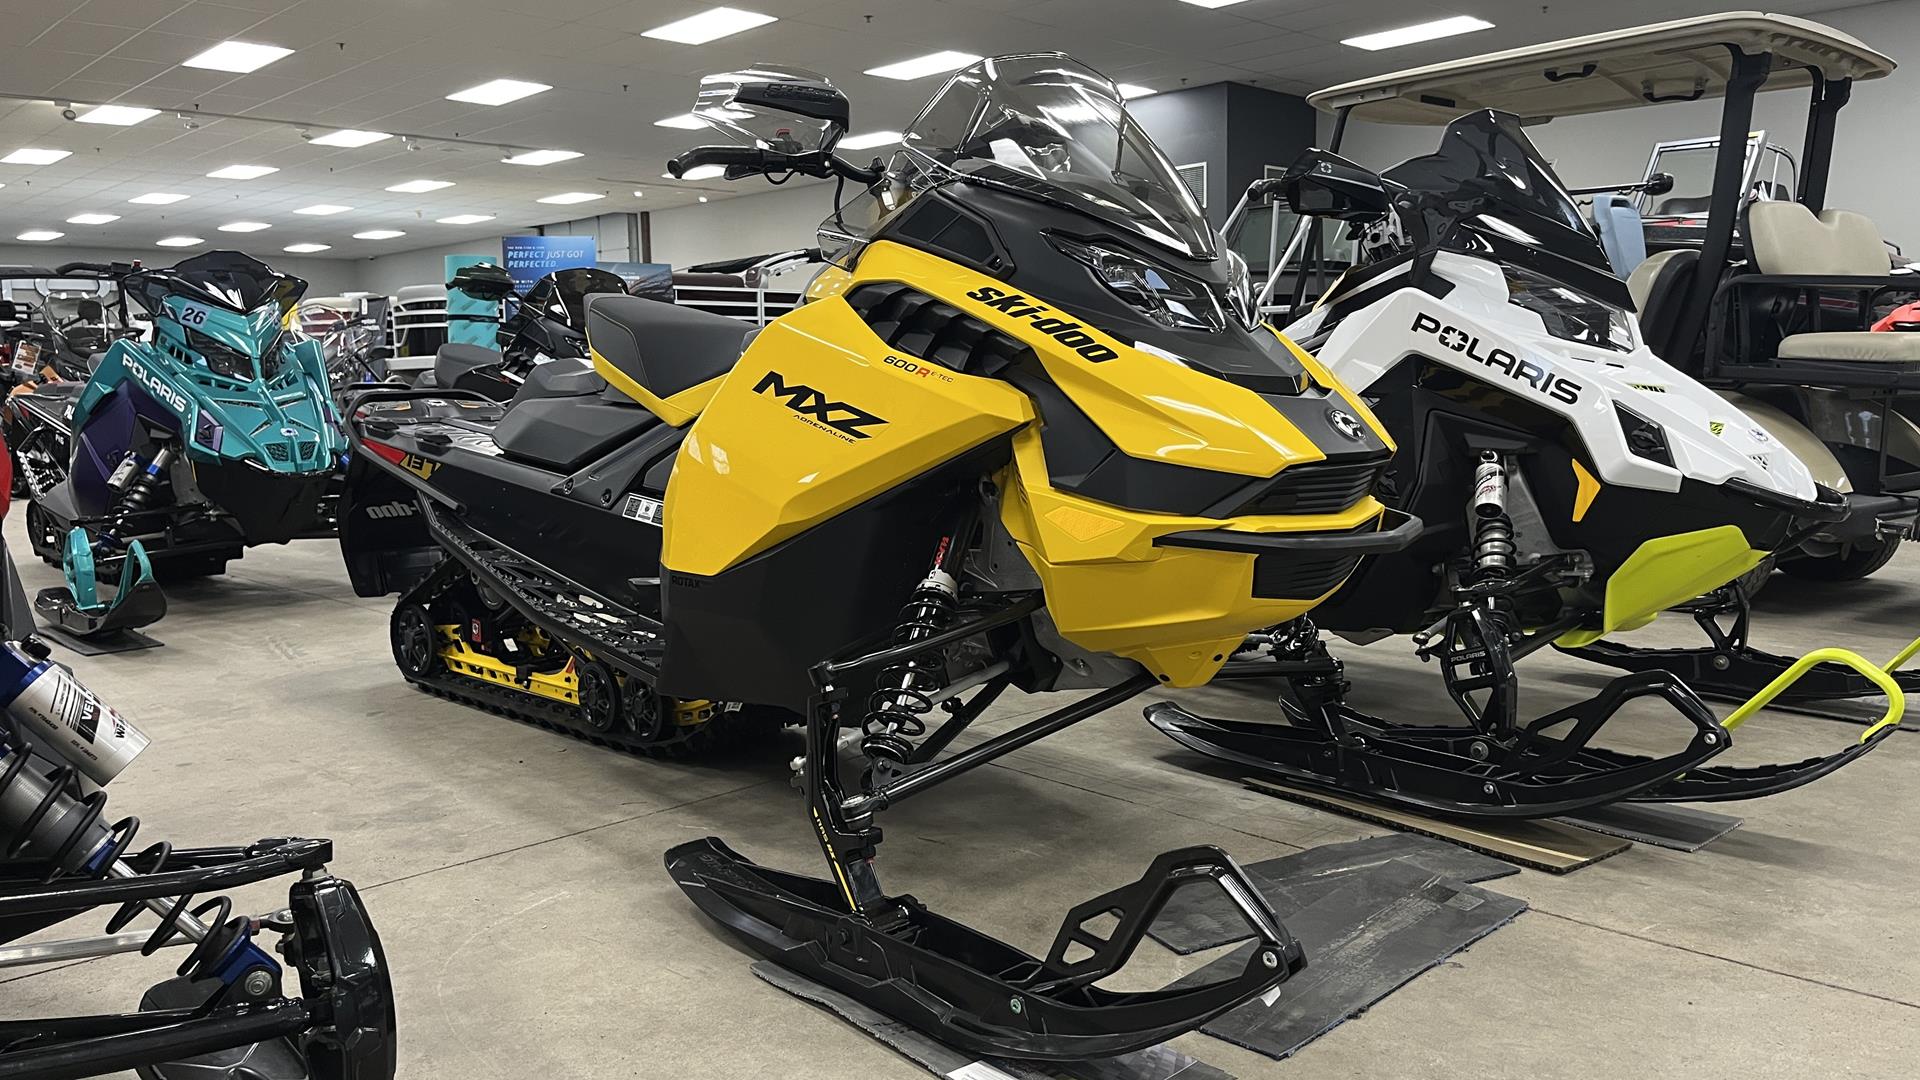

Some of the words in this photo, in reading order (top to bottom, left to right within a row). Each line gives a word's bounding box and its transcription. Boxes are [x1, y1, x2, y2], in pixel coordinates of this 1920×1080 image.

[507, 250, 544, 259] PERFECT
[545, 250, 565, 260] JUST
[567, 250, 584, 259] GOT
[181, 307, 206, 325] 26
[966, 287, 1119, 363] ski-doo
[1411, 312, 1583, 405] POLARIS
[122, 353, 187, 412] POLARIS
[751, 370, 891, 439] MXZ
[793, 414, 857, 445] ADRENALINE
[671, 575, 702, 589] ROTAX
[1450, 651, 1486, 662] POLARIS
